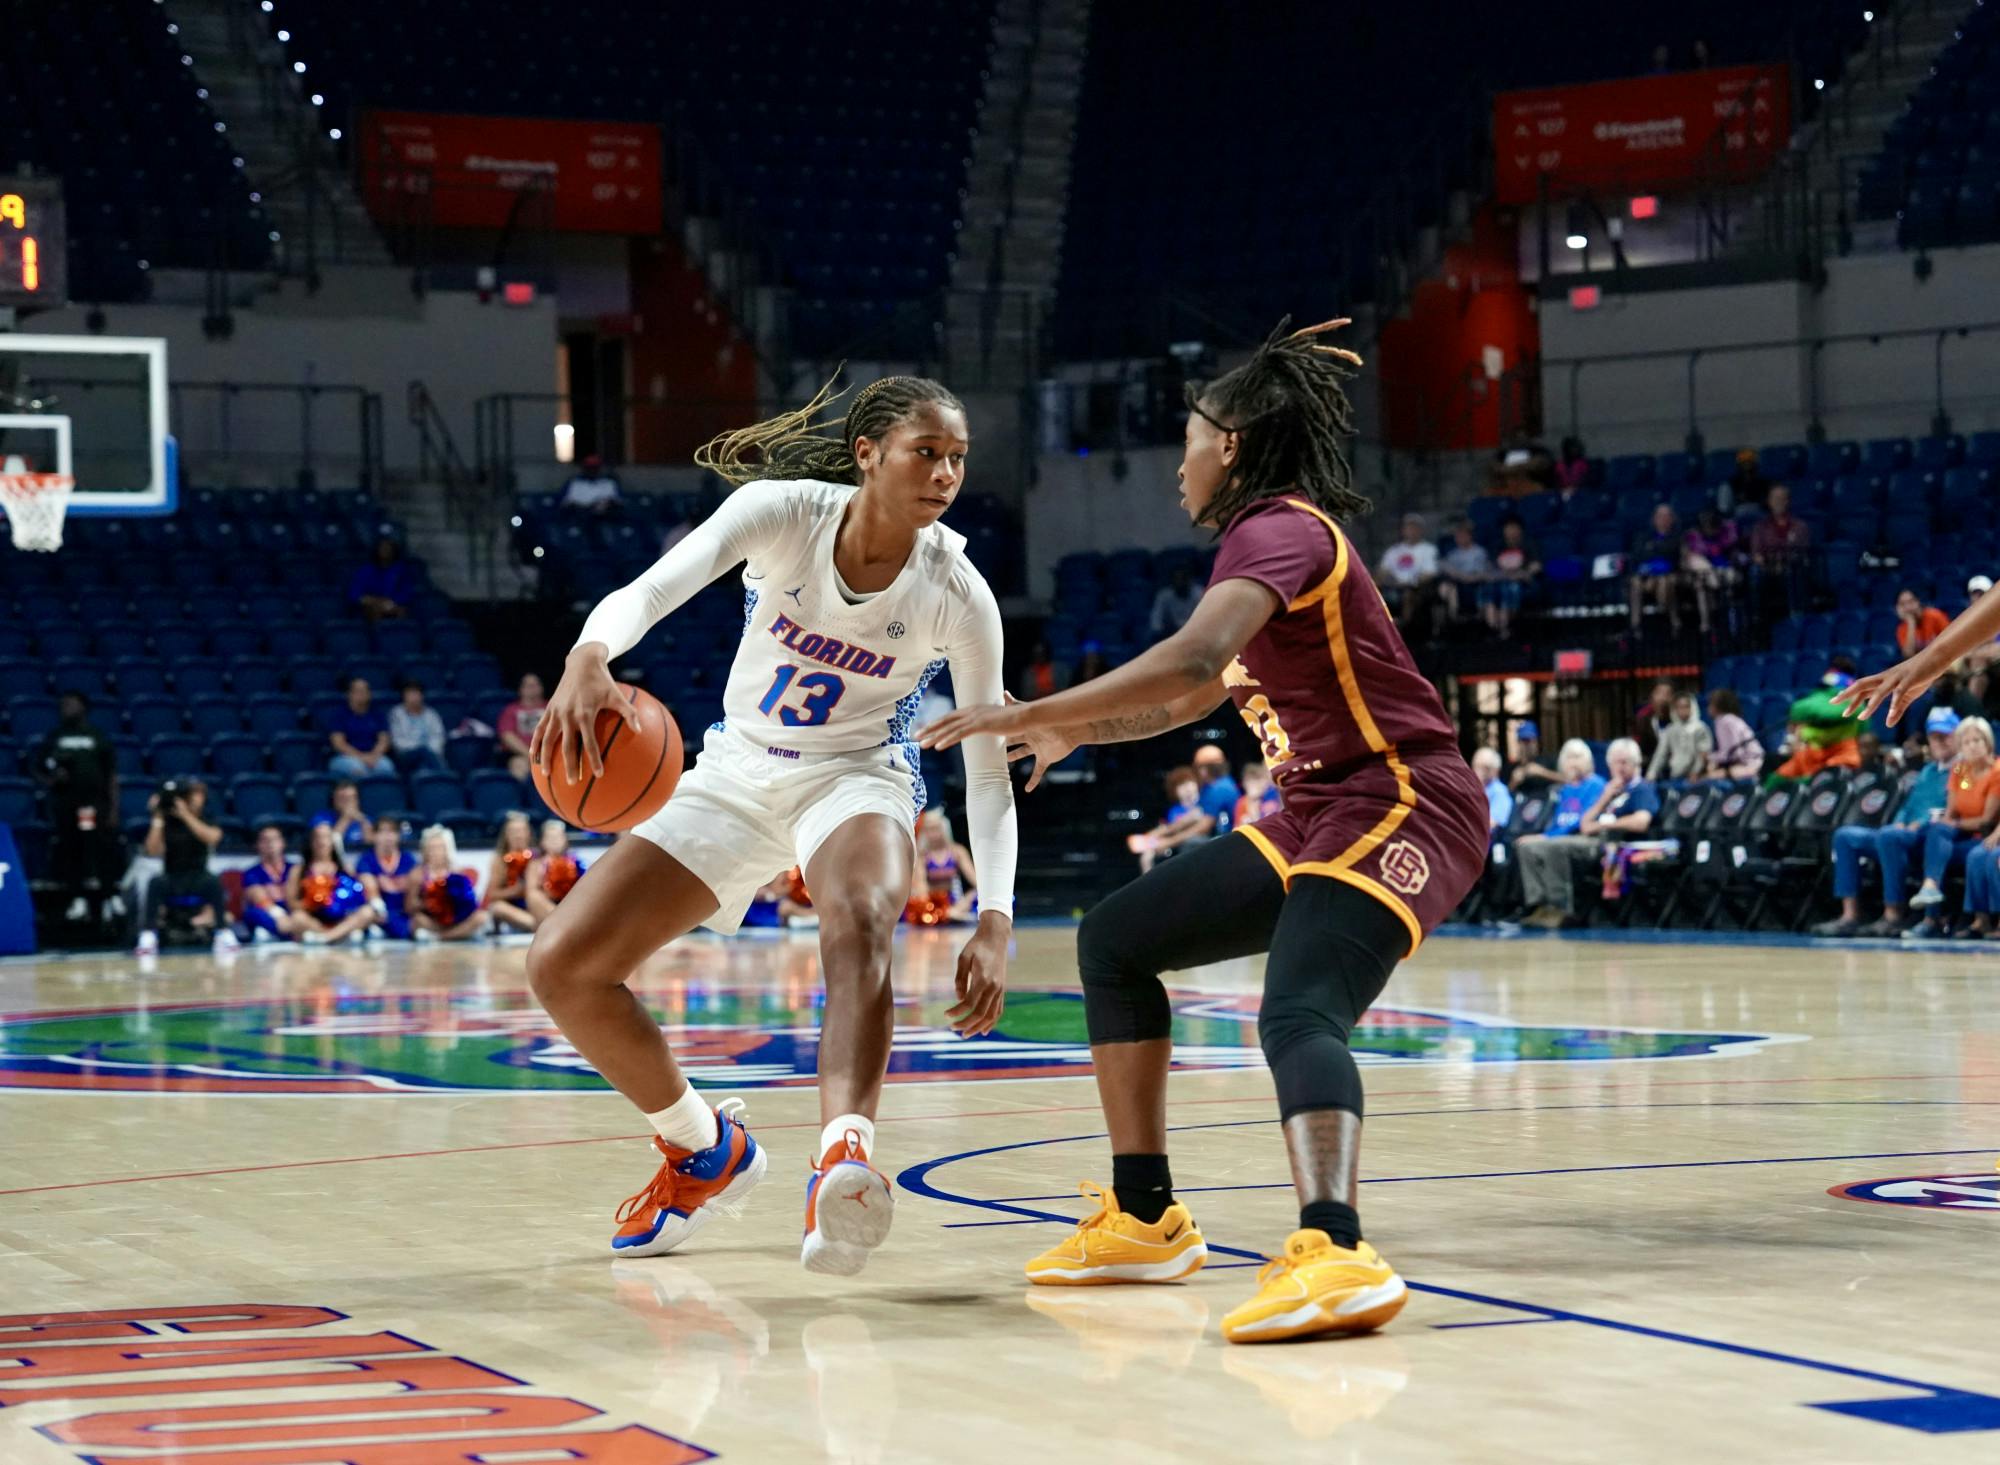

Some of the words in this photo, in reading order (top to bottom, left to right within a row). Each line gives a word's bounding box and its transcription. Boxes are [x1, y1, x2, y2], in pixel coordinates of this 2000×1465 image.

[767, 610, 897, 679] FLORIDA
[758, 664, 846, 727] 13
[767, 746, 801, 760] GATORS
